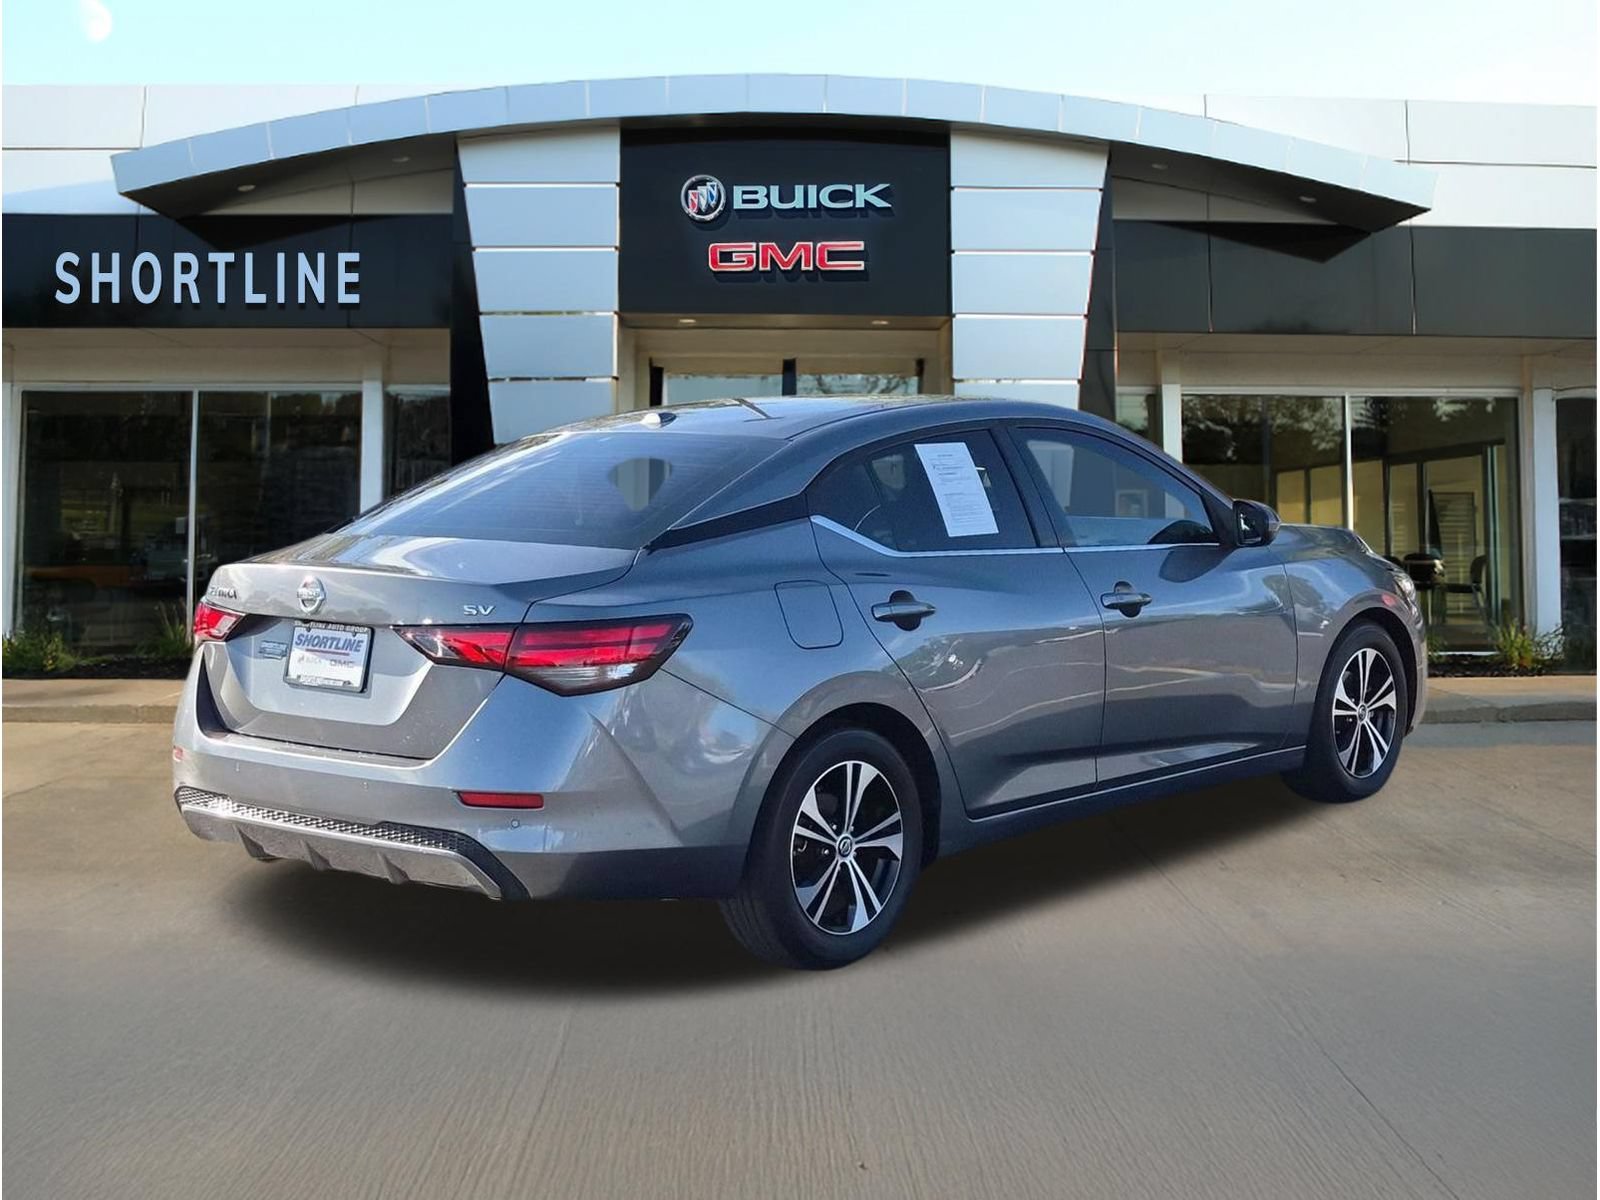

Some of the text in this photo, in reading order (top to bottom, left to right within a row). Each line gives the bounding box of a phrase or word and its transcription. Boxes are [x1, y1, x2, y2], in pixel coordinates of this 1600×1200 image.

[733, 183, 892, 210] BUICK
[708, 241, 865, 271] GMC
[55, 251, 361, 304] SHORTLINE
[463, 605, 494, 616] SV
[295, 633, 364, 653] SHORTLINE
